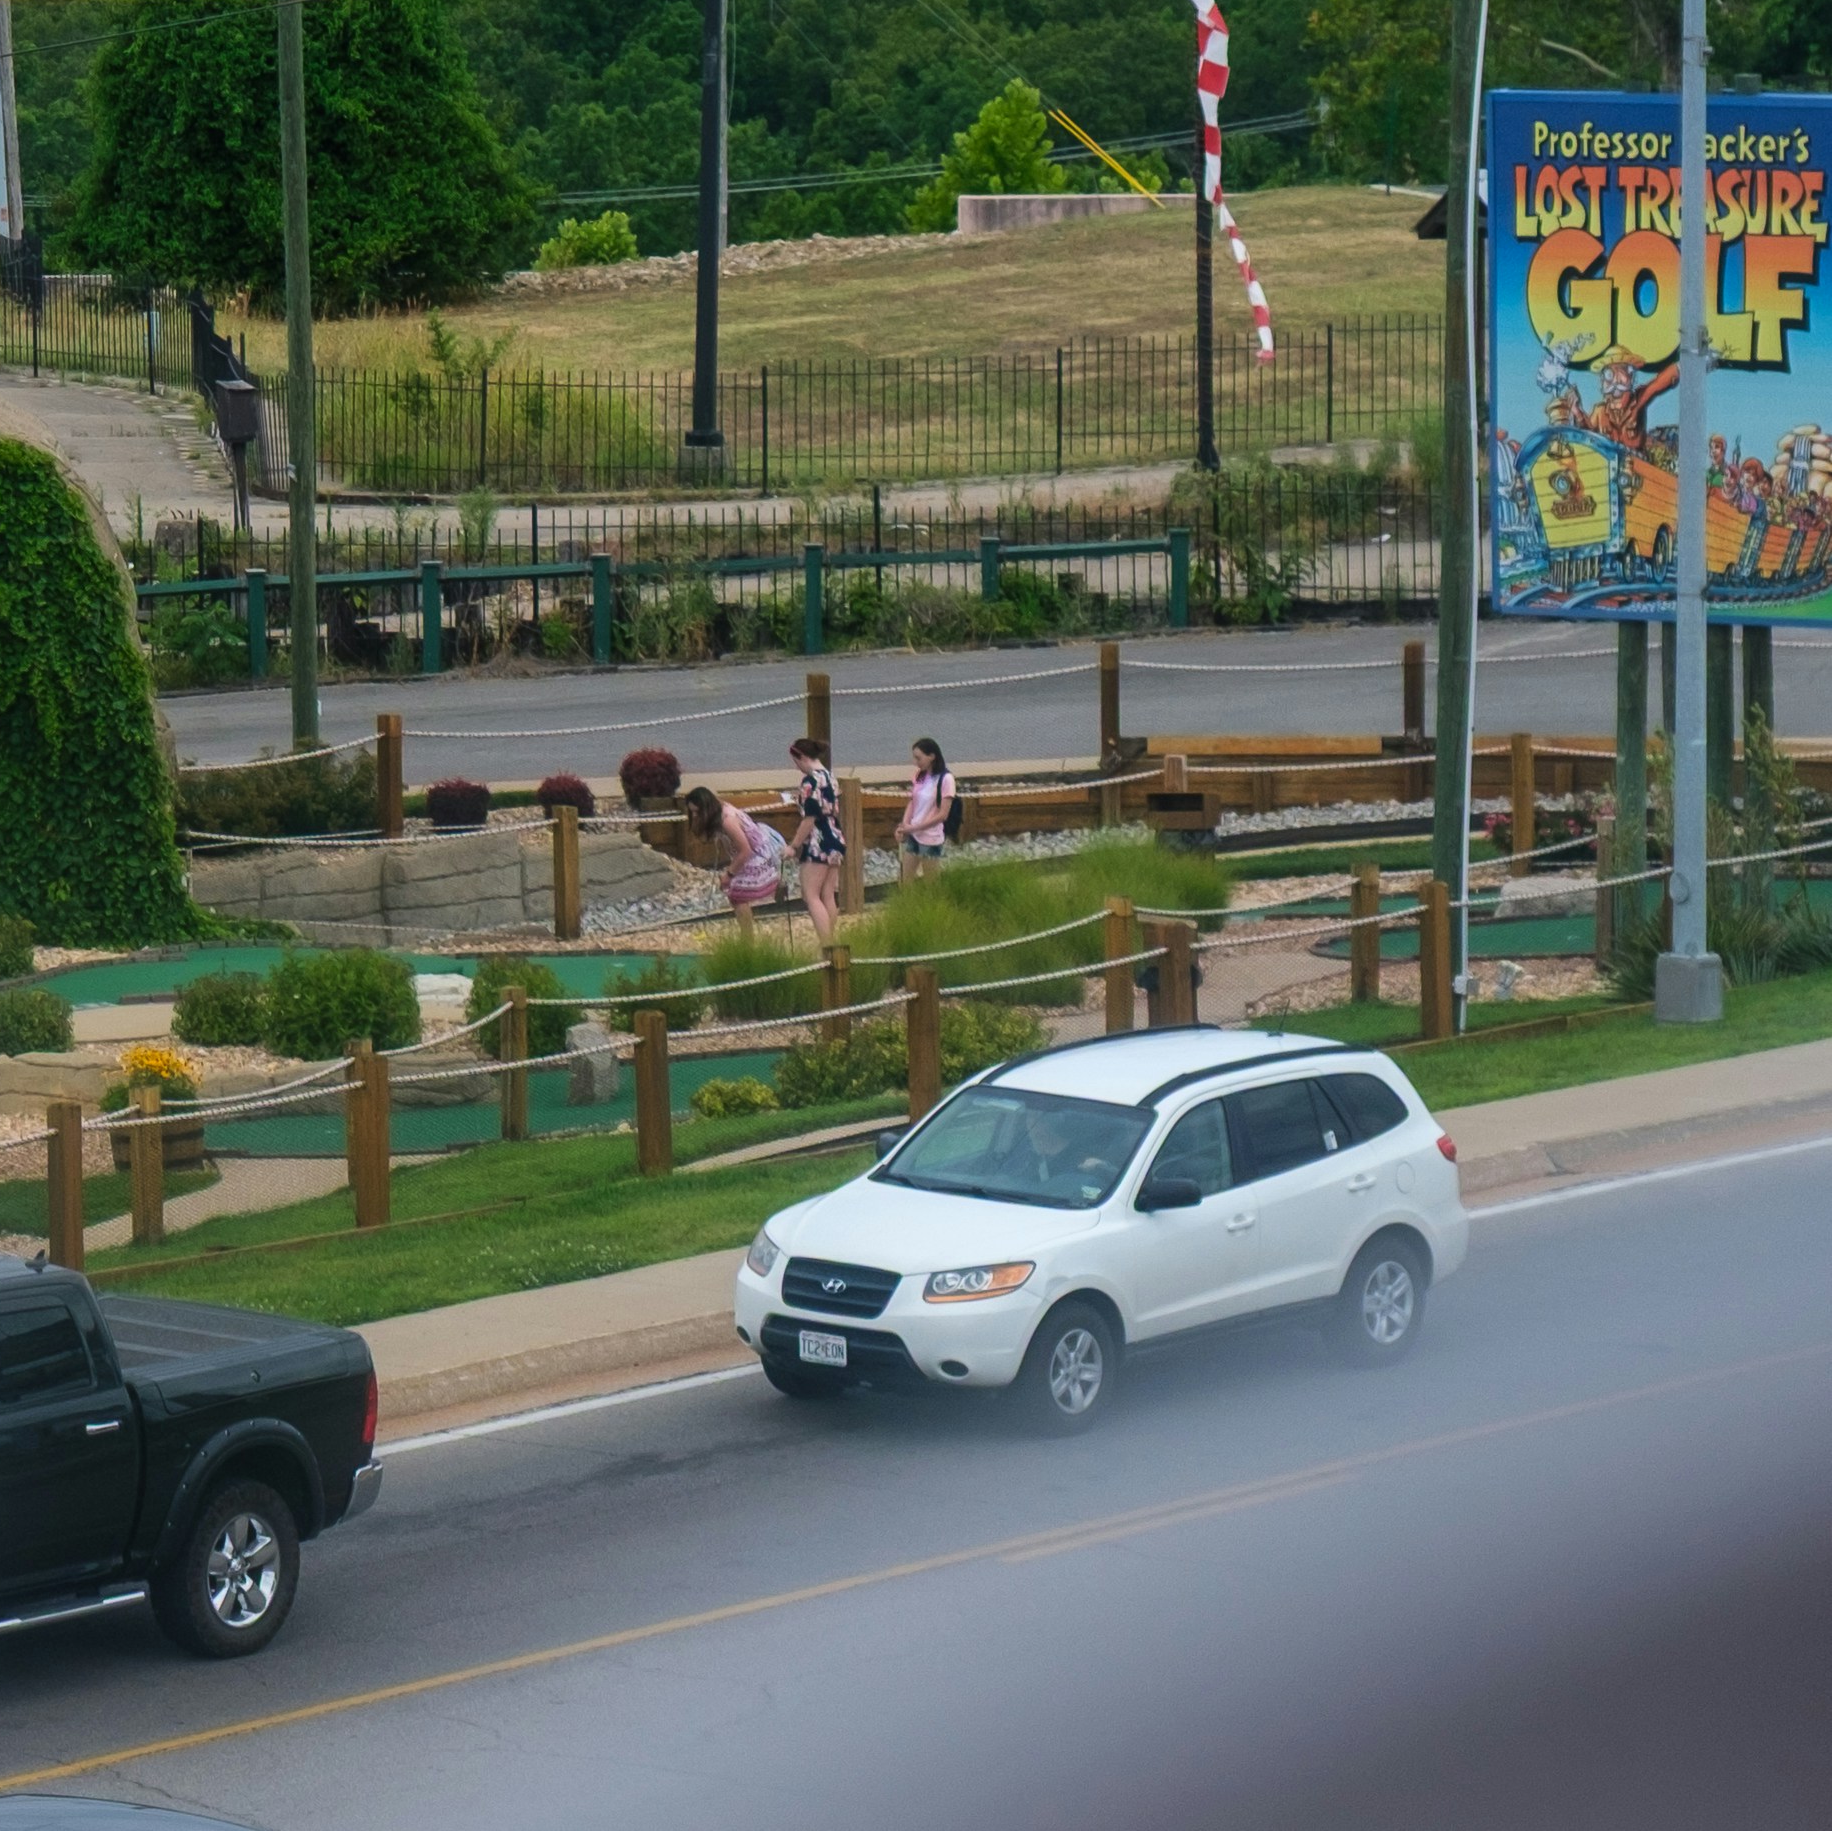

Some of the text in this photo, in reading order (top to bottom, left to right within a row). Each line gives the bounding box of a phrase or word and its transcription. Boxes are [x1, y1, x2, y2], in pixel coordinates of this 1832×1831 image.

[1533, 120, 1810, 164] Professor acker's
[1514, 164, 1607, 238] LOST
[1526, 226, 1816, 365] GOLF
